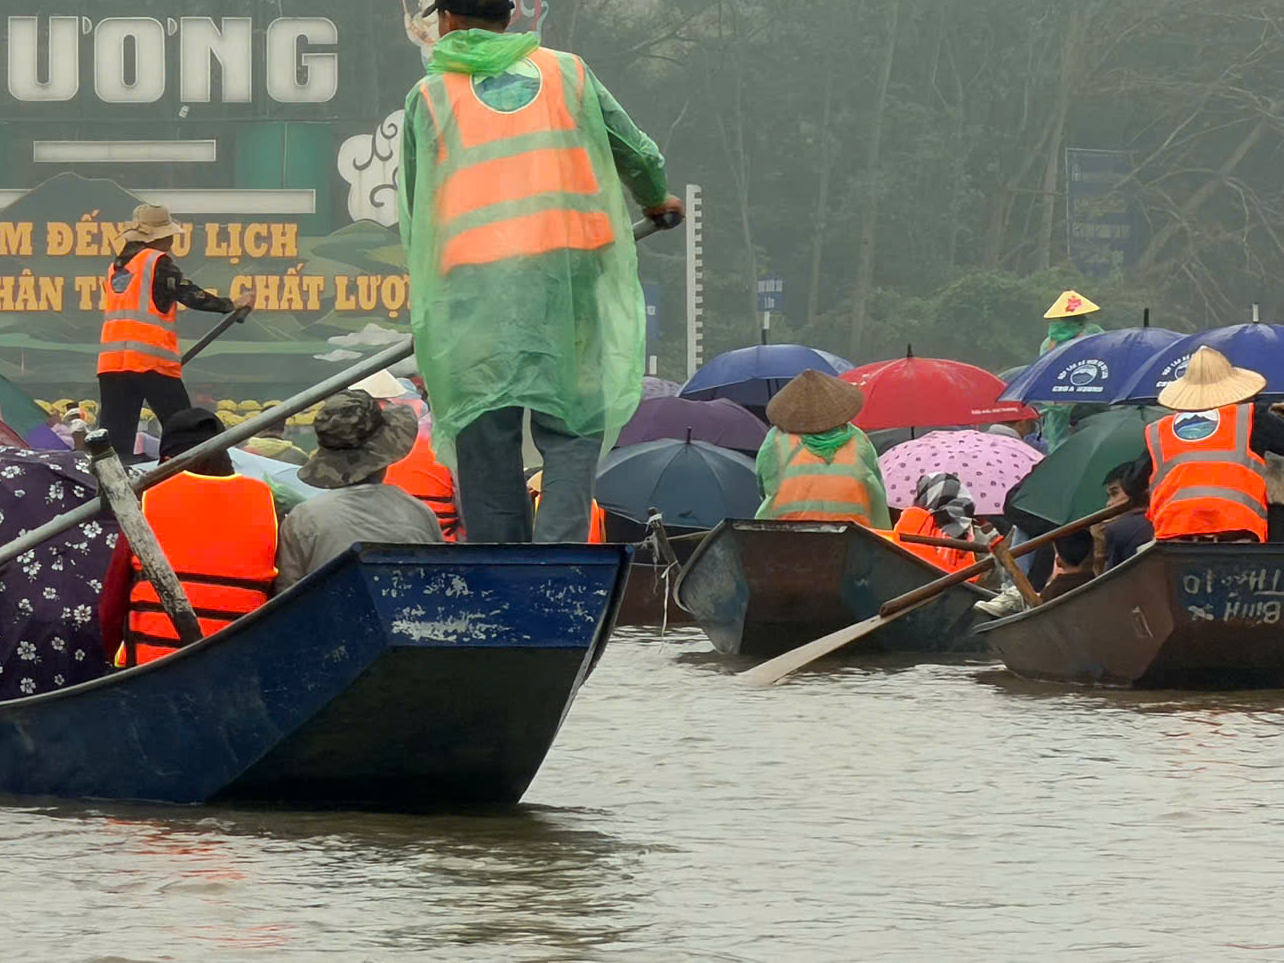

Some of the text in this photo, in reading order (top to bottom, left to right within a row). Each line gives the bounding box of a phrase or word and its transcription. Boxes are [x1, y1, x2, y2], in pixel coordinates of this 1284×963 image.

[205, 222, 299, 265] LỊCH
[229, 263, 412, 318] CHẤT LƯỢ
